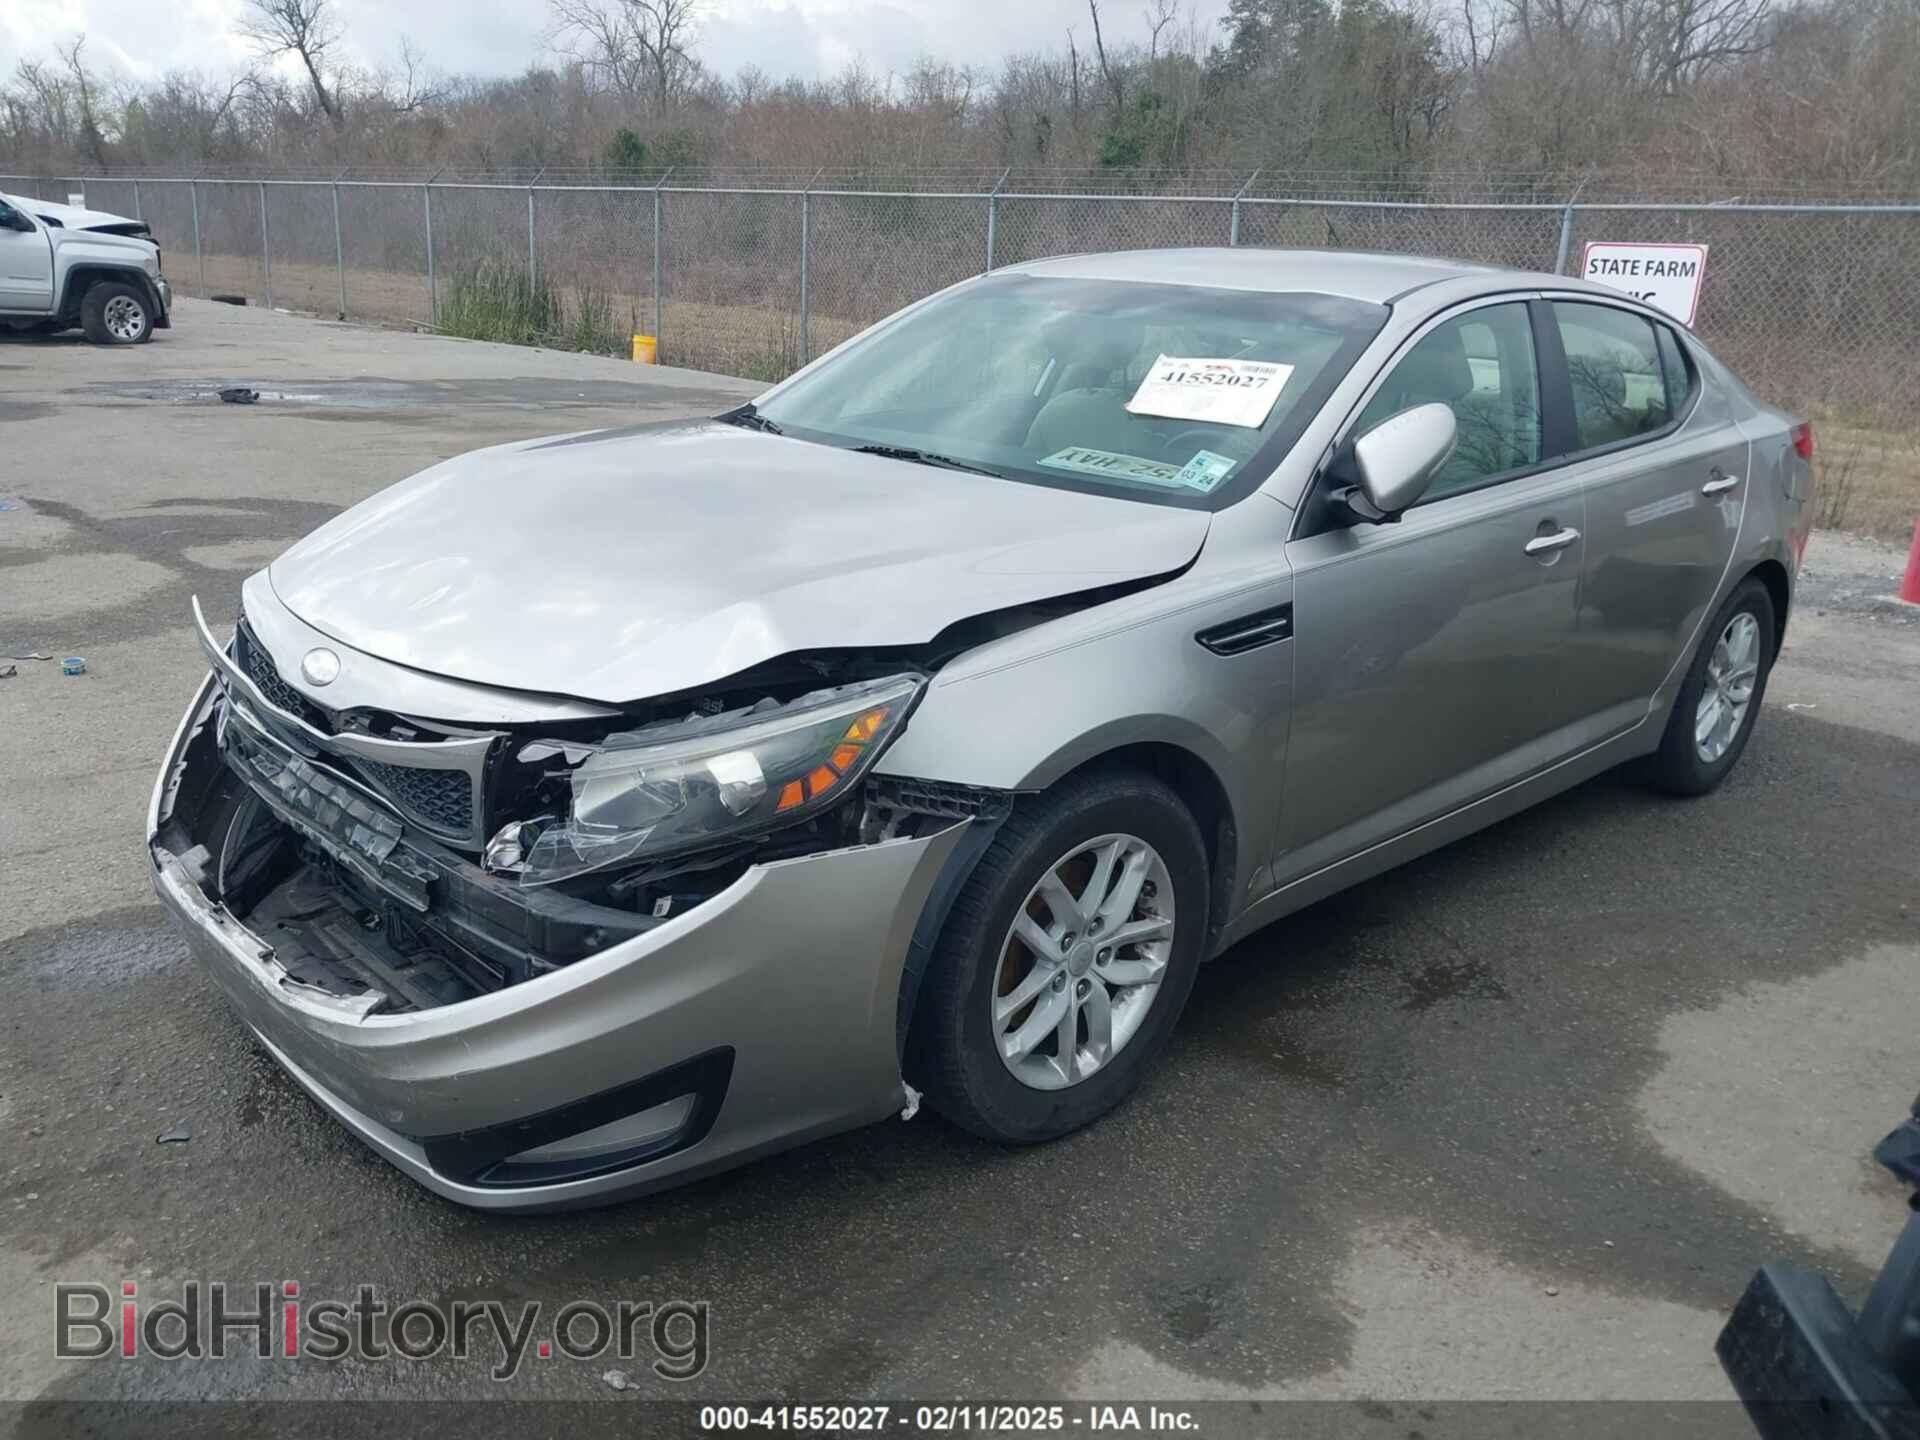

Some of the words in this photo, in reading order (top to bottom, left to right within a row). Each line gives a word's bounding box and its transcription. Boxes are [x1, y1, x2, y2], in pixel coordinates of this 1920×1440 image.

[1589, 258, 1640, 276] STATE
[1645, 260, 1696, 278] FARM
[1160, 371, 1270, 389] 41552027
[1057, 450, 1118, 468] HAY
